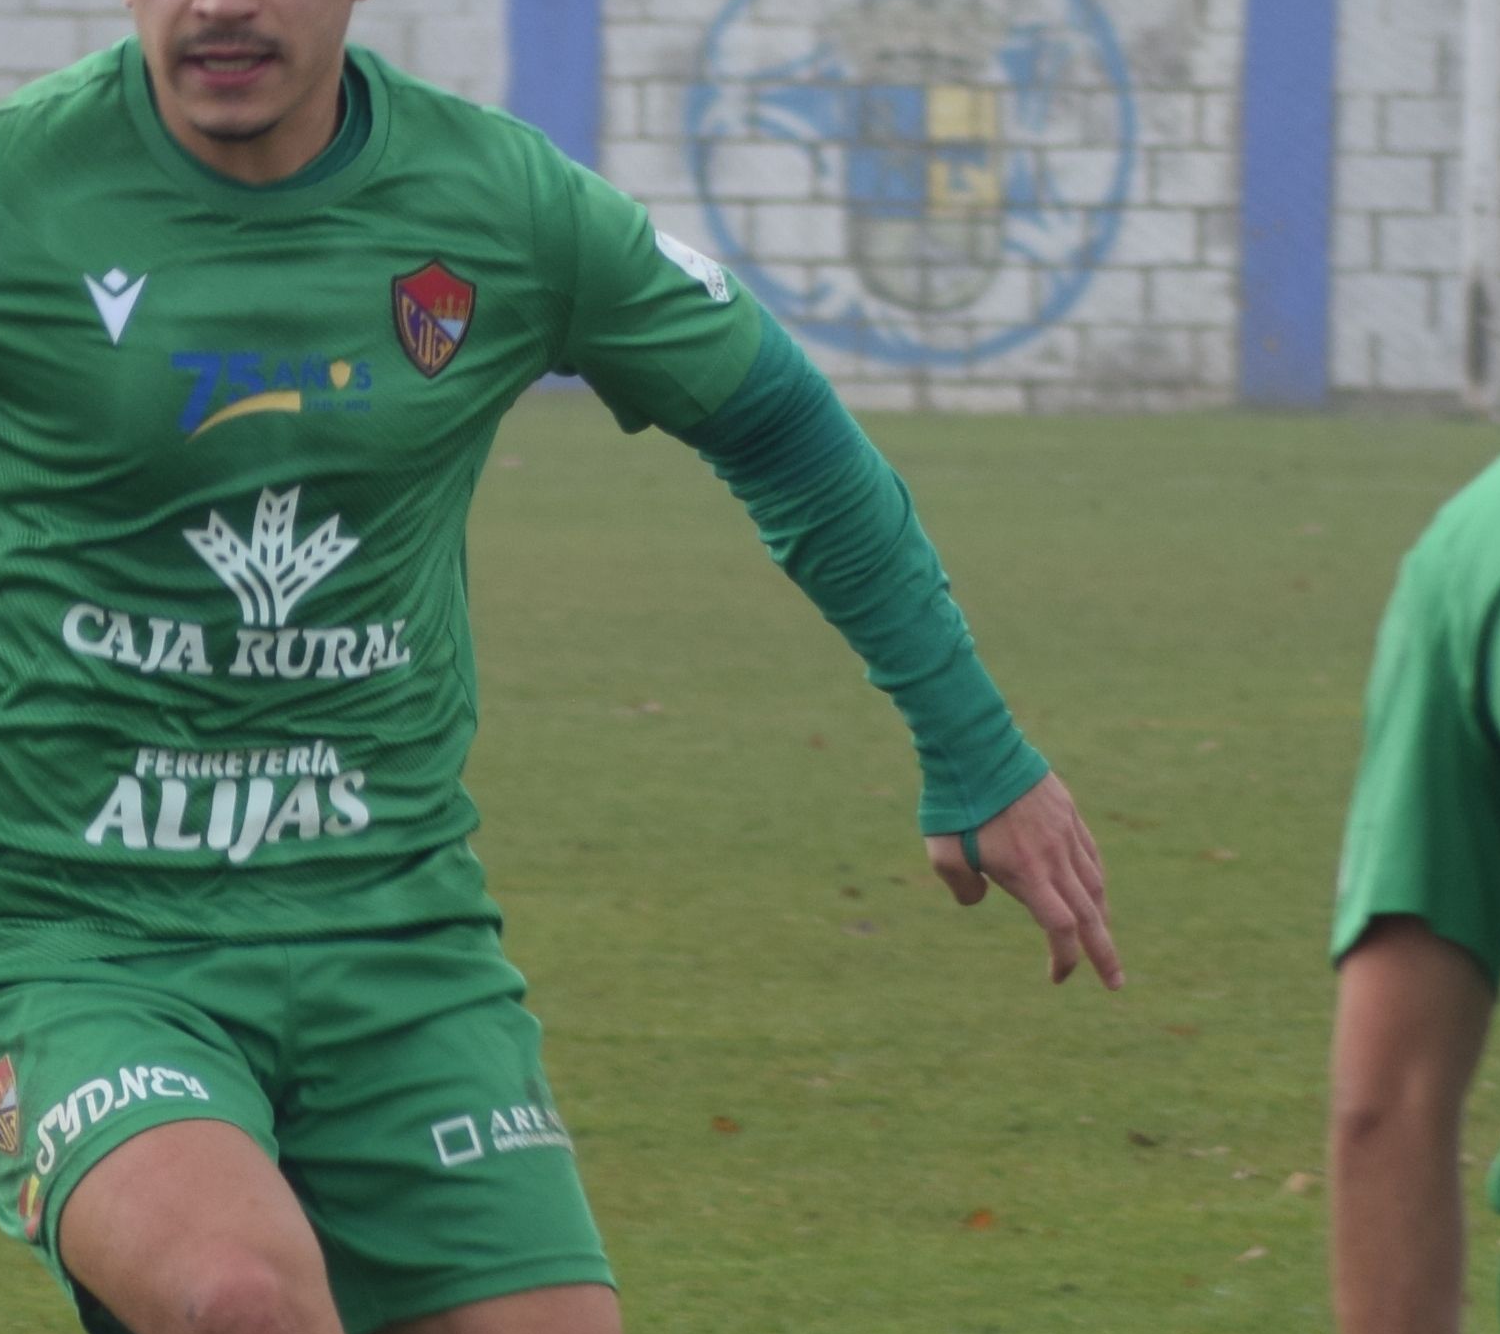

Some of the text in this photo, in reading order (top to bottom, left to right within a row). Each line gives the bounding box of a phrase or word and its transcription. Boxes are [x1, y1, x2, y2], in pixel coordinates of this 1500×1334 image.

[62, 603, 411, 679] CAJA RURAL
[135, 738, 341, 779] FERRETERÍA
[85, 769, 370, 863] ALIJAS
